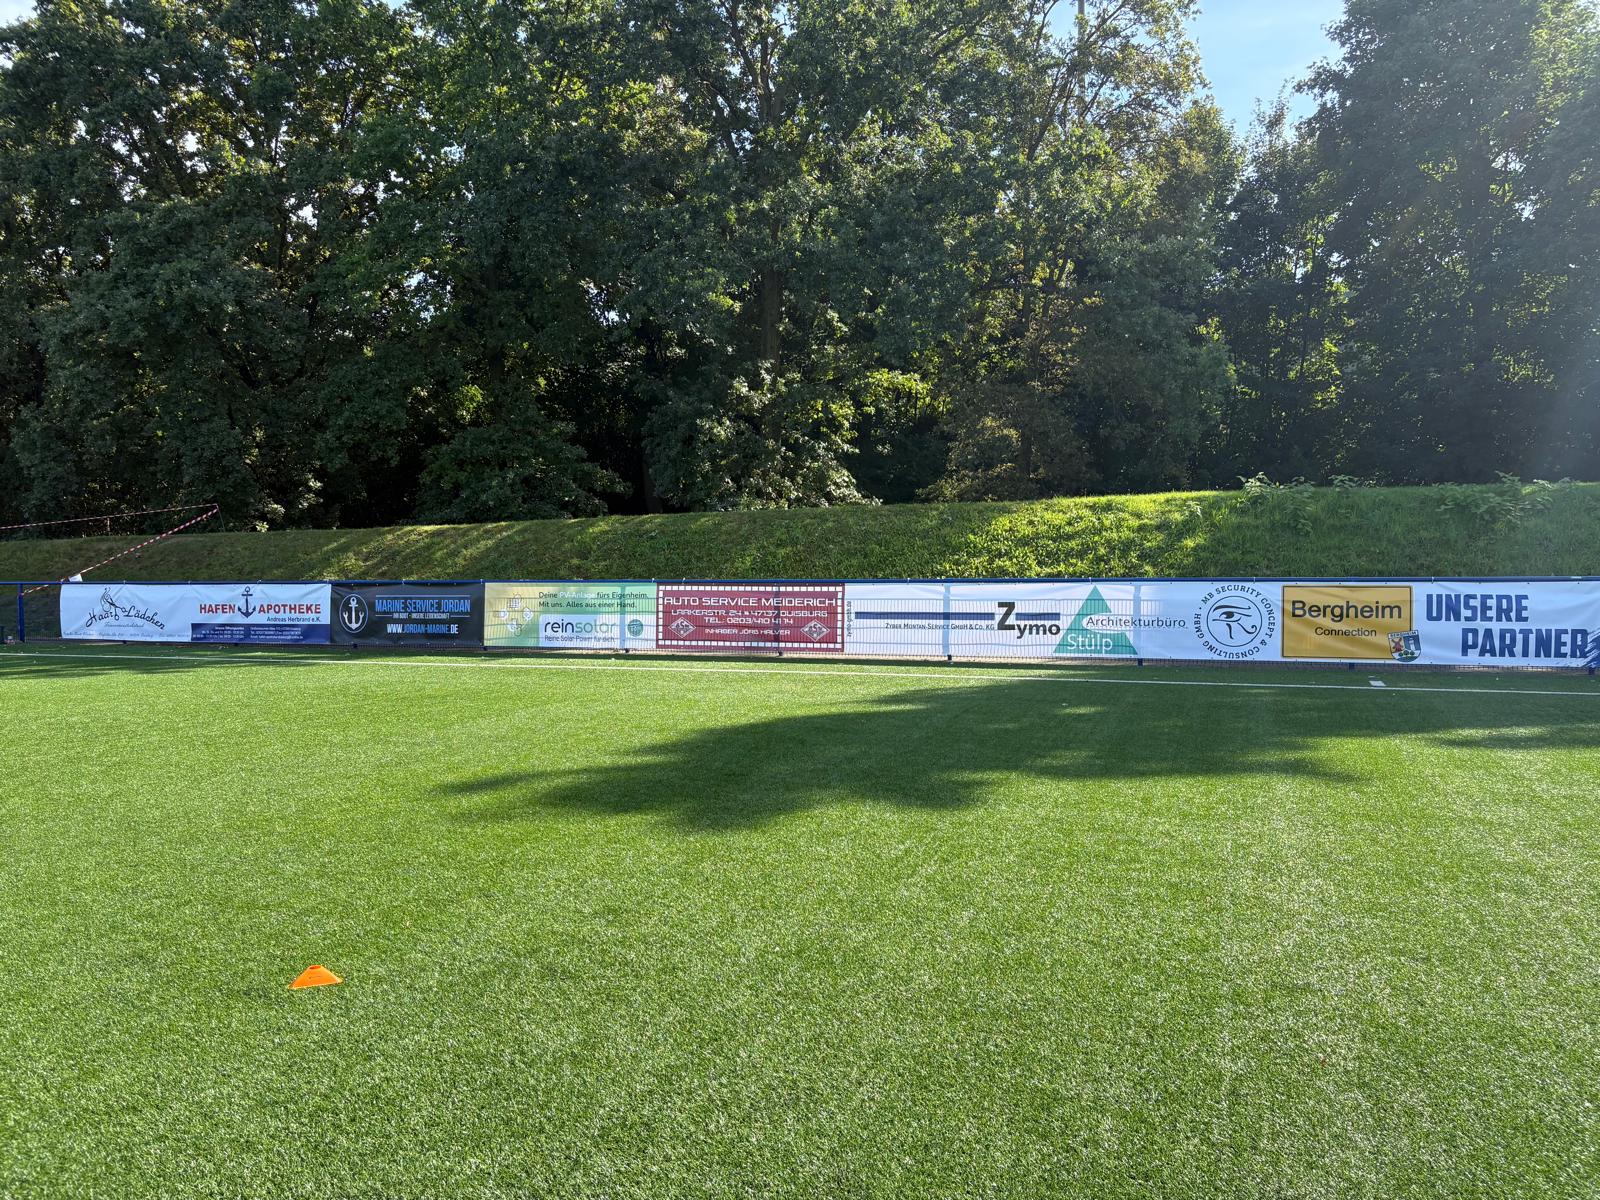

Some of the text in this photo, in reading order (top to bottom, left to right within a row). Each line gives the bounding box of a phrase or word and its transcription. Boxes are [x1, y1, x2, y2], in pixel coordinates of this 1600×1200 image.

[538, 591, 649, 600] Deine PV-Anlage fürs Eigenheim.
[1215, 584, 1262, 598] SECURITY
[664, 597, 836, 608] AUTO SERVICE MEIDERICH
[1201, 592, 1215, 605] MB
[199, 603, 236, 614] HAFEN
[258, 603, 321, 614] APOTHEKE
[375, 599, 471, 613] MARINE SERVICE JORDAN
[1291, 600, 1402, 623] Bergheim
[1426, 593, 1529, 622] UNSERE
[85, 605, 165, 630] Haar Lädchen
[729, 609, 742, 617] 24
[750, 610, 778, 618] 47137
[997, 601, 1061, 639] Zymo
[1260, 597, 1276, 639] CONCEPT
[386, 623, 459, 634] WWW.JORDAN-MARINE.DE
[544, 618, 616, 634] reinsolar
[1086, 616, 1187, 628] Architekturbüro
[1193, 612, 1205, 640] GMBH
[544, 634, 559, 642] Reine
[1314, 626, 1377, 637] Connection
[1067, 633, 1113, 654] Stülp
[1202, 640, 1261, 660] CONSULTING
[1461, 627, 1589, 659] PARTNER
